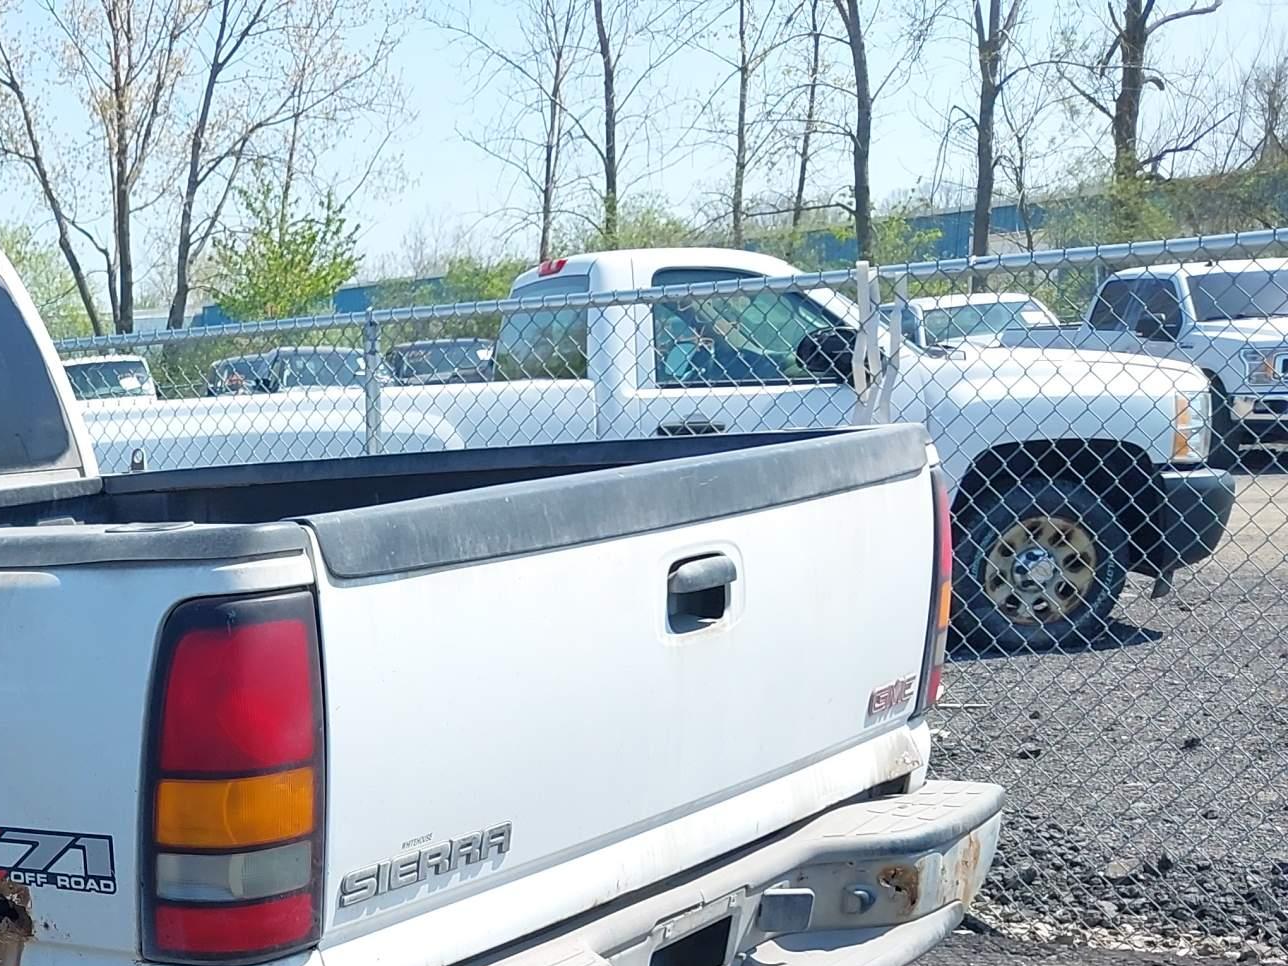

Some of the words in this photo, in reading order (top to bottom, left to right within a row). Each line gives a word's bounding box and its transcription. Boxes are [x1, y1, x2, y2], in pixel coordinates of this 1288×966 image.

[868, 673, 916, 716] GMC
[9, 871, 48, 886] OFF
[56, 875, 116, 894] ROAD
[339, 820, 512, 908] SIERRA
